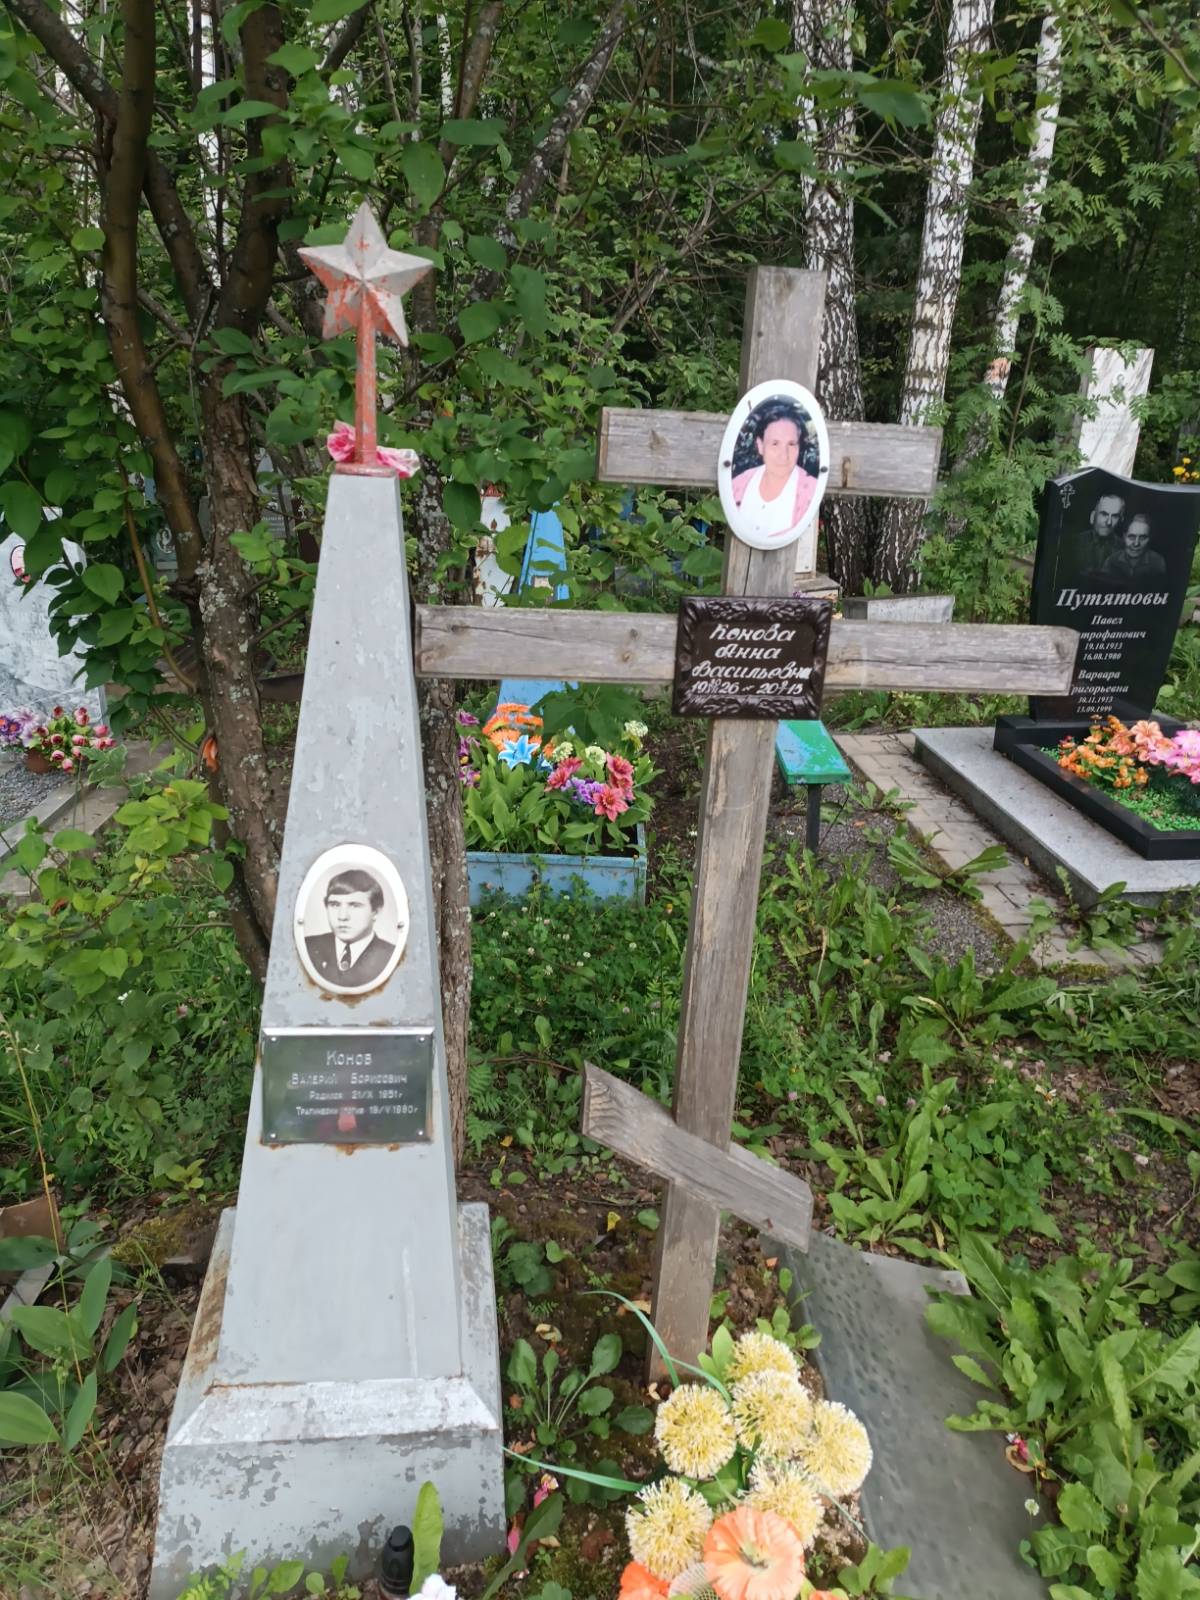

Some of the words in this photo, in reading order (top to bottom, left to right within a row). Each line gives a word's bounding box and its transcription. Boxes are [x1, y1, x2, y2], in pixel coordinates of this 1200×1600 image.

[1056, 588, 1169, 611] Путятовы
[1091, 615, 1123, 625] Павел
[709, 623, 796, 642] Конова
[1080, 629, 1147, 641] трофанович
[715, 643, 782, 660] Анна
[1078, 669, 1121, 682] Варвара
[1071, 685, 1129, 696] ригорьевна
